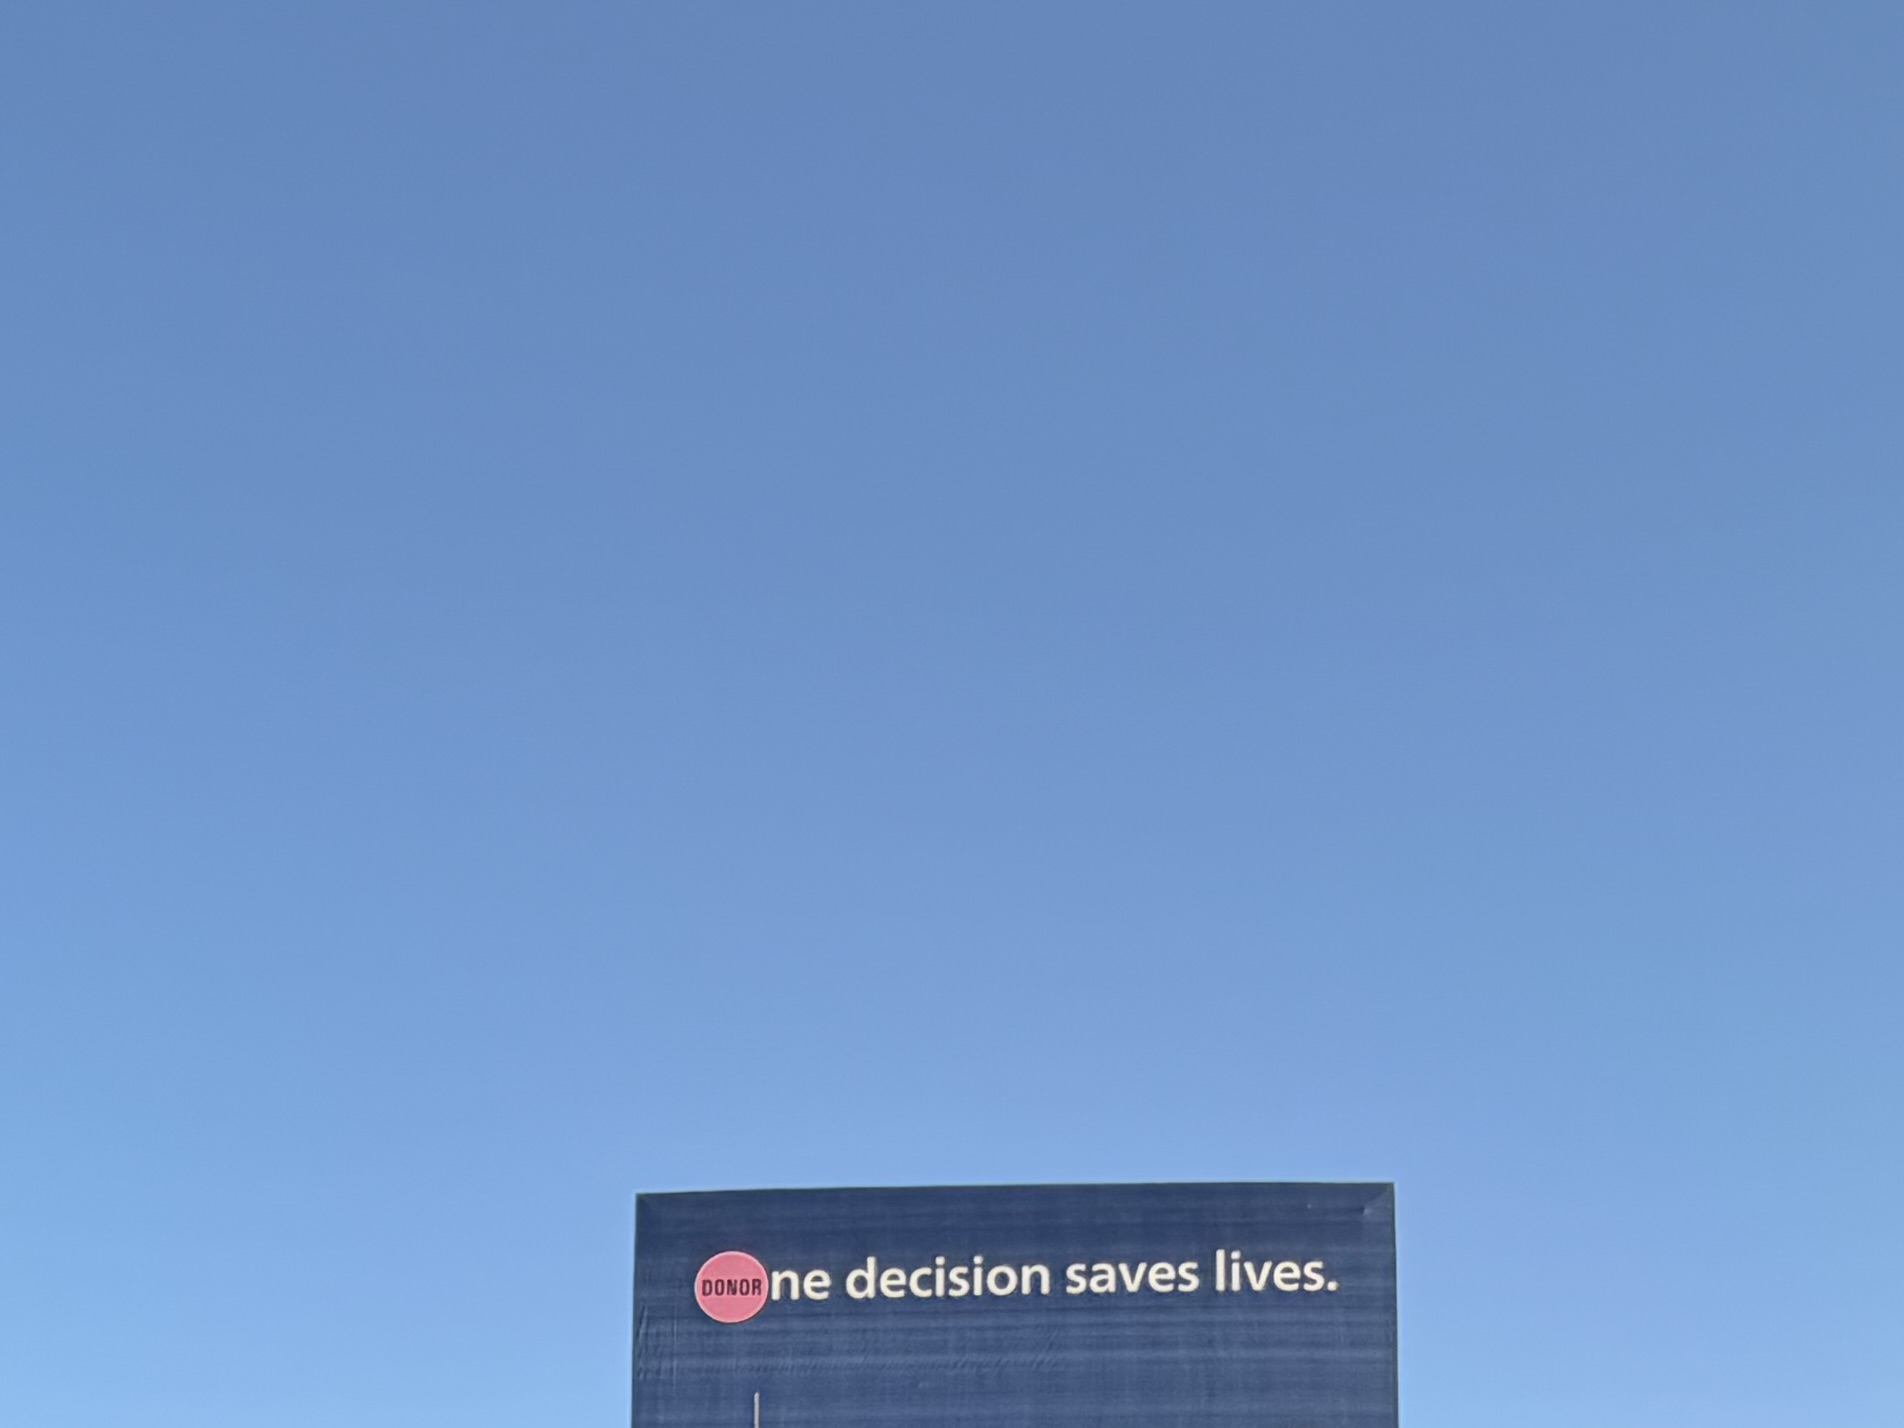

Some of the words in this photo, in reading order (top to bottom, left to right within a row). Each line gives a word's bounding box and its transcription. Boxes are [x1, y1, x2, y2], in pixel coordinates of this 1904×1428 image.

[701, 1278, 762, 1297] DONOR
[846, 1255, 1050, 1299] decision
[1065, 1261, 1200, 1294] saves
[1215, 1249, 1339, 1292] lives.
